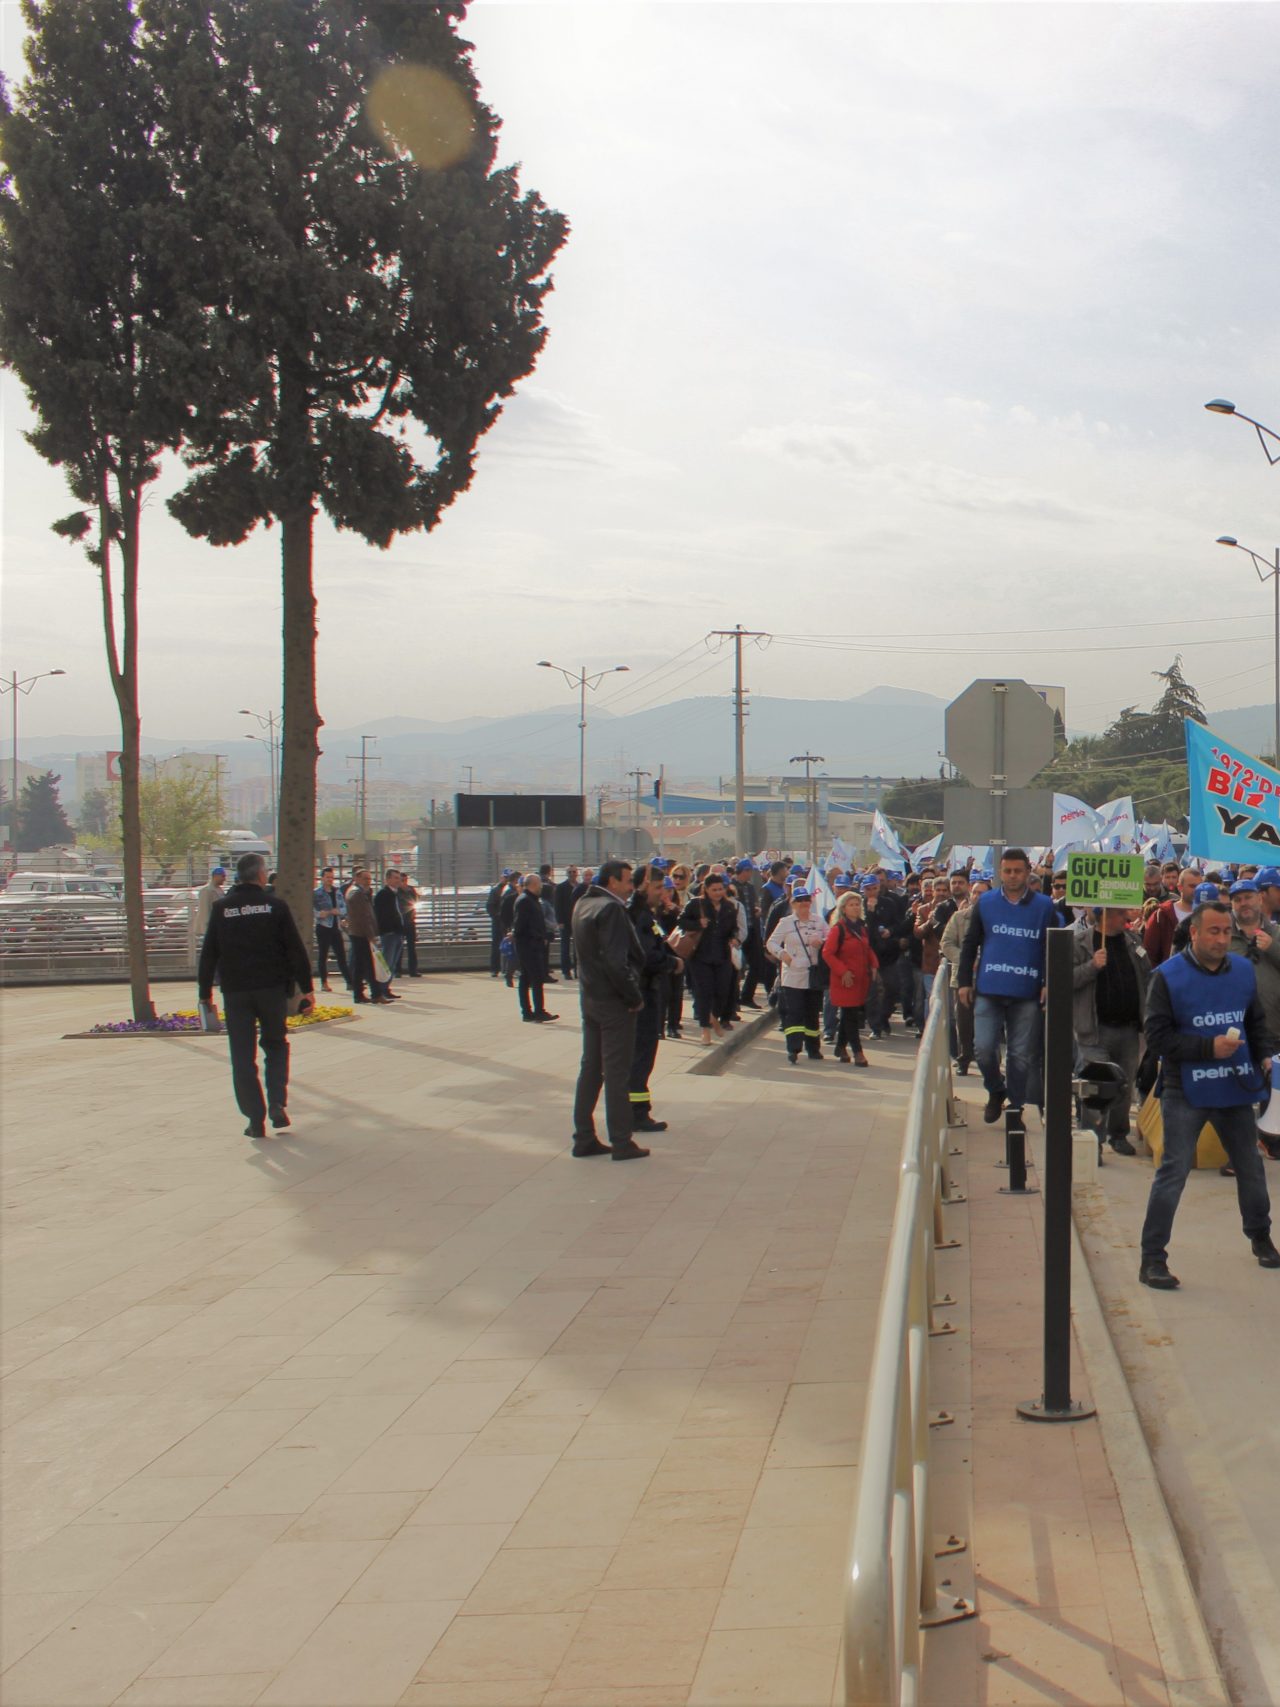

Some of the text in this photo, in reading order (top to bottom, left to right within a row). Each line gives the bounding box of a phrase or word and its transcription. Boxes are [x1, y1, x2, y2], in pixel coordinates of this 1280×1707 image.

[1071, 857, 1131, 880] GÜÇLÜ
[1071, 878, 1099, 899] OL!
[991, 923, 1041, 940] GÖREVLİ
[984, 963, 1039, 980] petrol-iş
